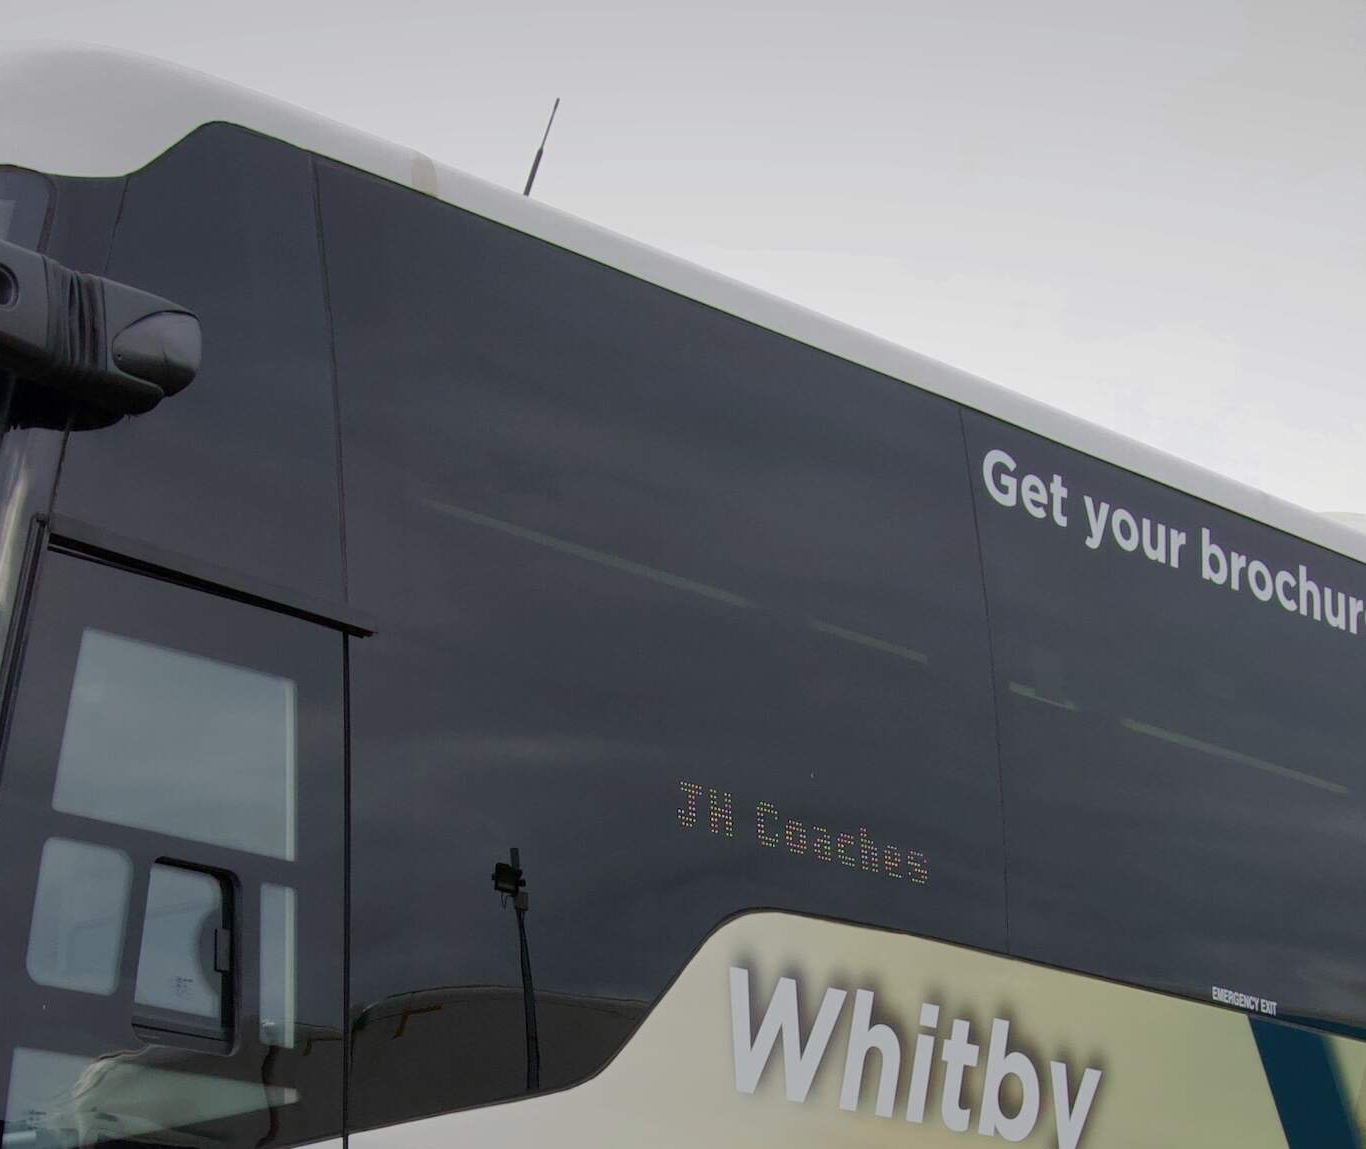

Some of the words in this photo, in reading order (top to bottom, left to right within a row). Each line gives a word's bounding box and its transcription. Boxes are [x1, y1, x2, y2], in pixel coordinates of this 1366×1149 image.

[981, 448, 1069, 528] Get
[1083, 494, 1187, 569] your
[677, 780, 734, 838] JH
[755, 800, 929, 885] Coaches
[1211, 985, 1260, 1012] EMERGENCY
[1260, 998, 1278, 1016] EXIT
